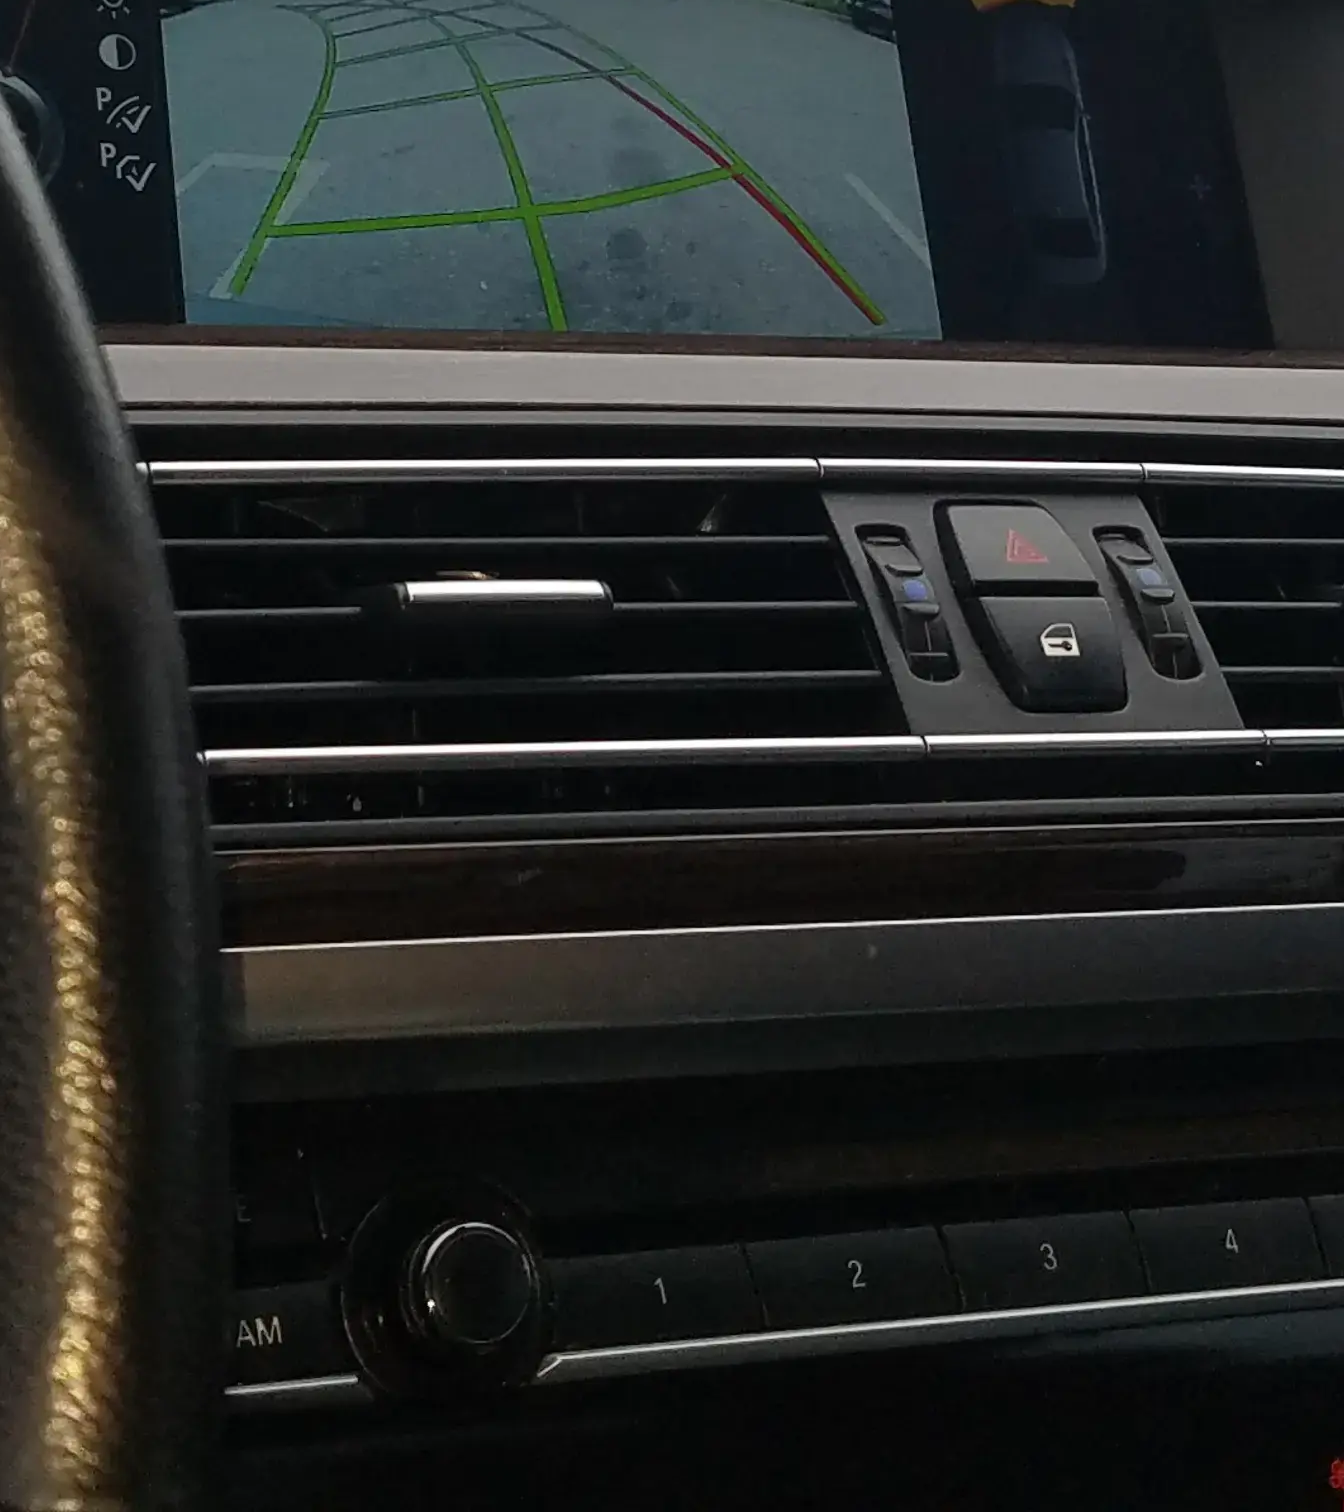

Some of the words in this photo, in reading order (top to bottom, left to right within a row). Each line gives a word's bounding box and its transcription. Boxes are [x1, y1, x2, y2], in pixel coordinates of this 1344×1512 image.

[95, 86, 112, 111] P
[99, 142, 117, 167] P
[653, 1277, 668, 1305] 1
[847, 1259, 867, 1289] 2
[1039, 1242, 1059, 1271] 3
[1224, 1228, 1240, 1255] 4
[235, 1315, 283, 1348] AM
